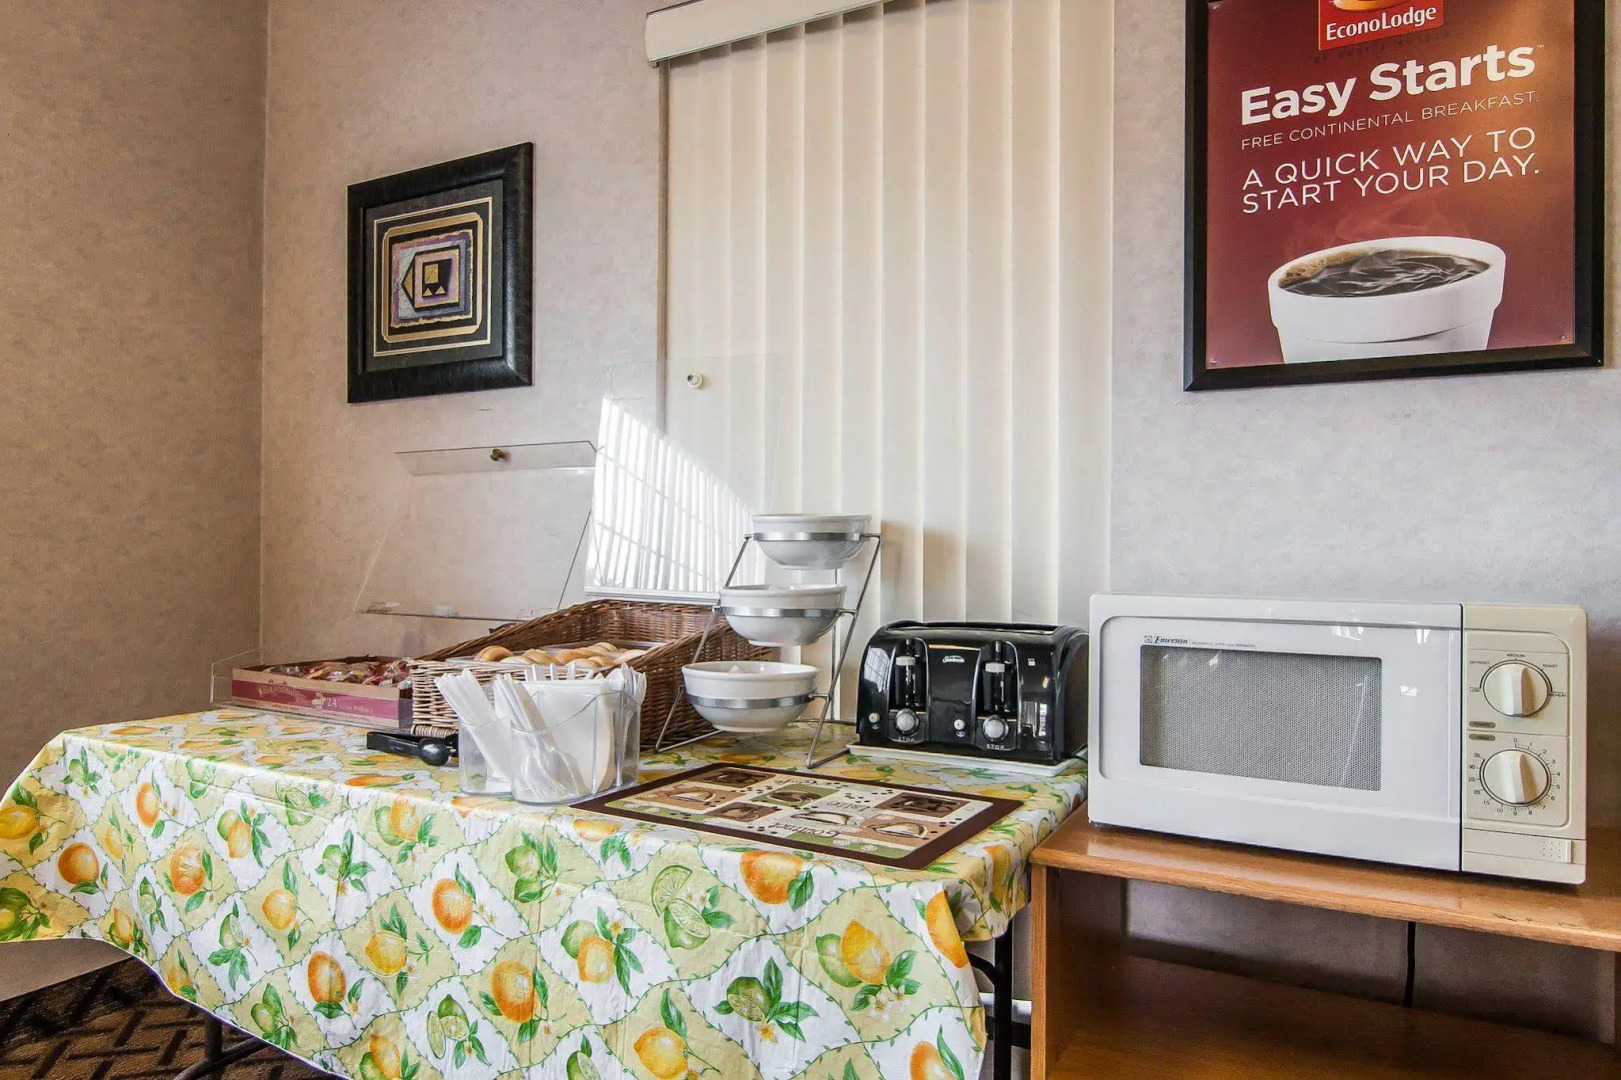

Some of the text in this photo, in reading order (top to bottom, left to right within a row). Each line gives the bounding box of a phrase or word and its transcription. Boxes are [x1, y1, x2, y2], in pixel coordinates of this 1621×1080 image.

[1326, 6, 1437, 41] EconoLodge
[1241, 44, 1536, 126] Easy Starts
[1241, 133, 1283, 150] FREE
[1289, 111, 1414, 142] CONTINENTAL
[1242, 126, 1536, 191] A QUICK WAY TO
[1242, 153, 1540, 214] START YOUR DAY.
[1154, 636, 1188, 645] Emerson
